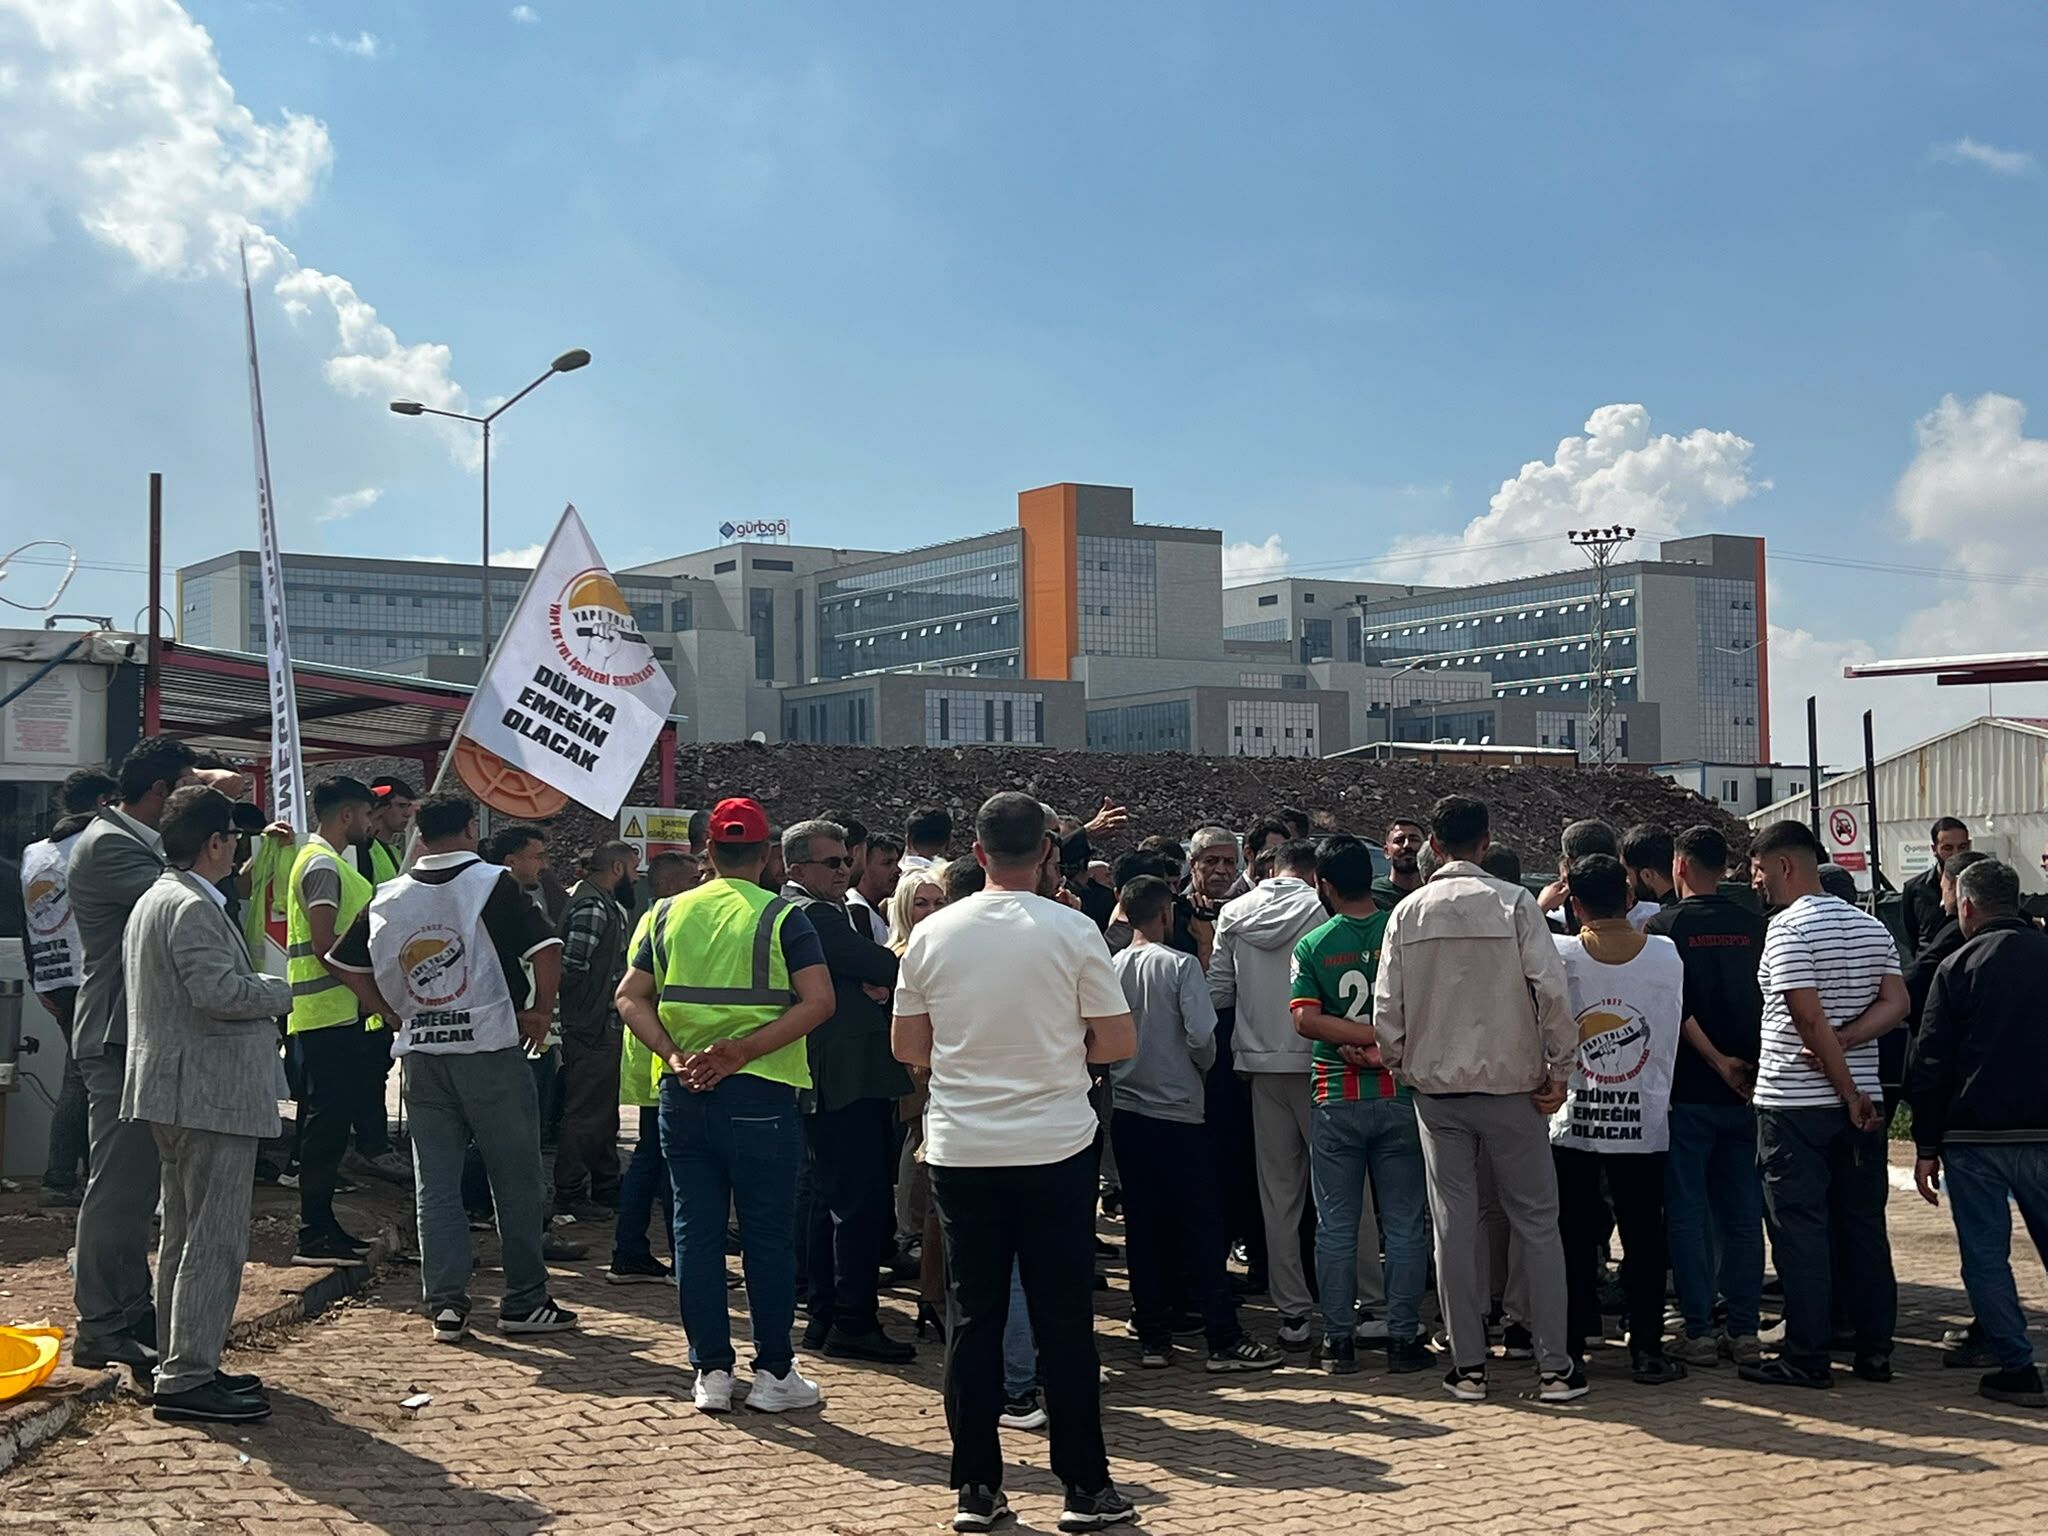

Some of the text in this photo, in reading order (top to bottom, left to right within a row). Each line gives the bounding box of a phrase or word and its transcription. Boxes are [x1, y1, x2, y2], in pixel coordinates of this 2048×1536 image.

[736, 519, 786, 537] gürbağ
[573, 610, 602, 622] YAPI
[556, 641, 573, 661] YOL
[532, 664, 617, 725] DÜNYA
[517, 686, 609, 748] EMEĞİN
[501, 708, 600, 773] OLACAK
[1582, 1037, 1602, 1052] YAPI
[1576, 1087, 1640, 1105] DÜNYA
[1573, 1106, 1641, 1122] EMEĞİN
[1571, 1123, 1643, 1140] OLACAK
